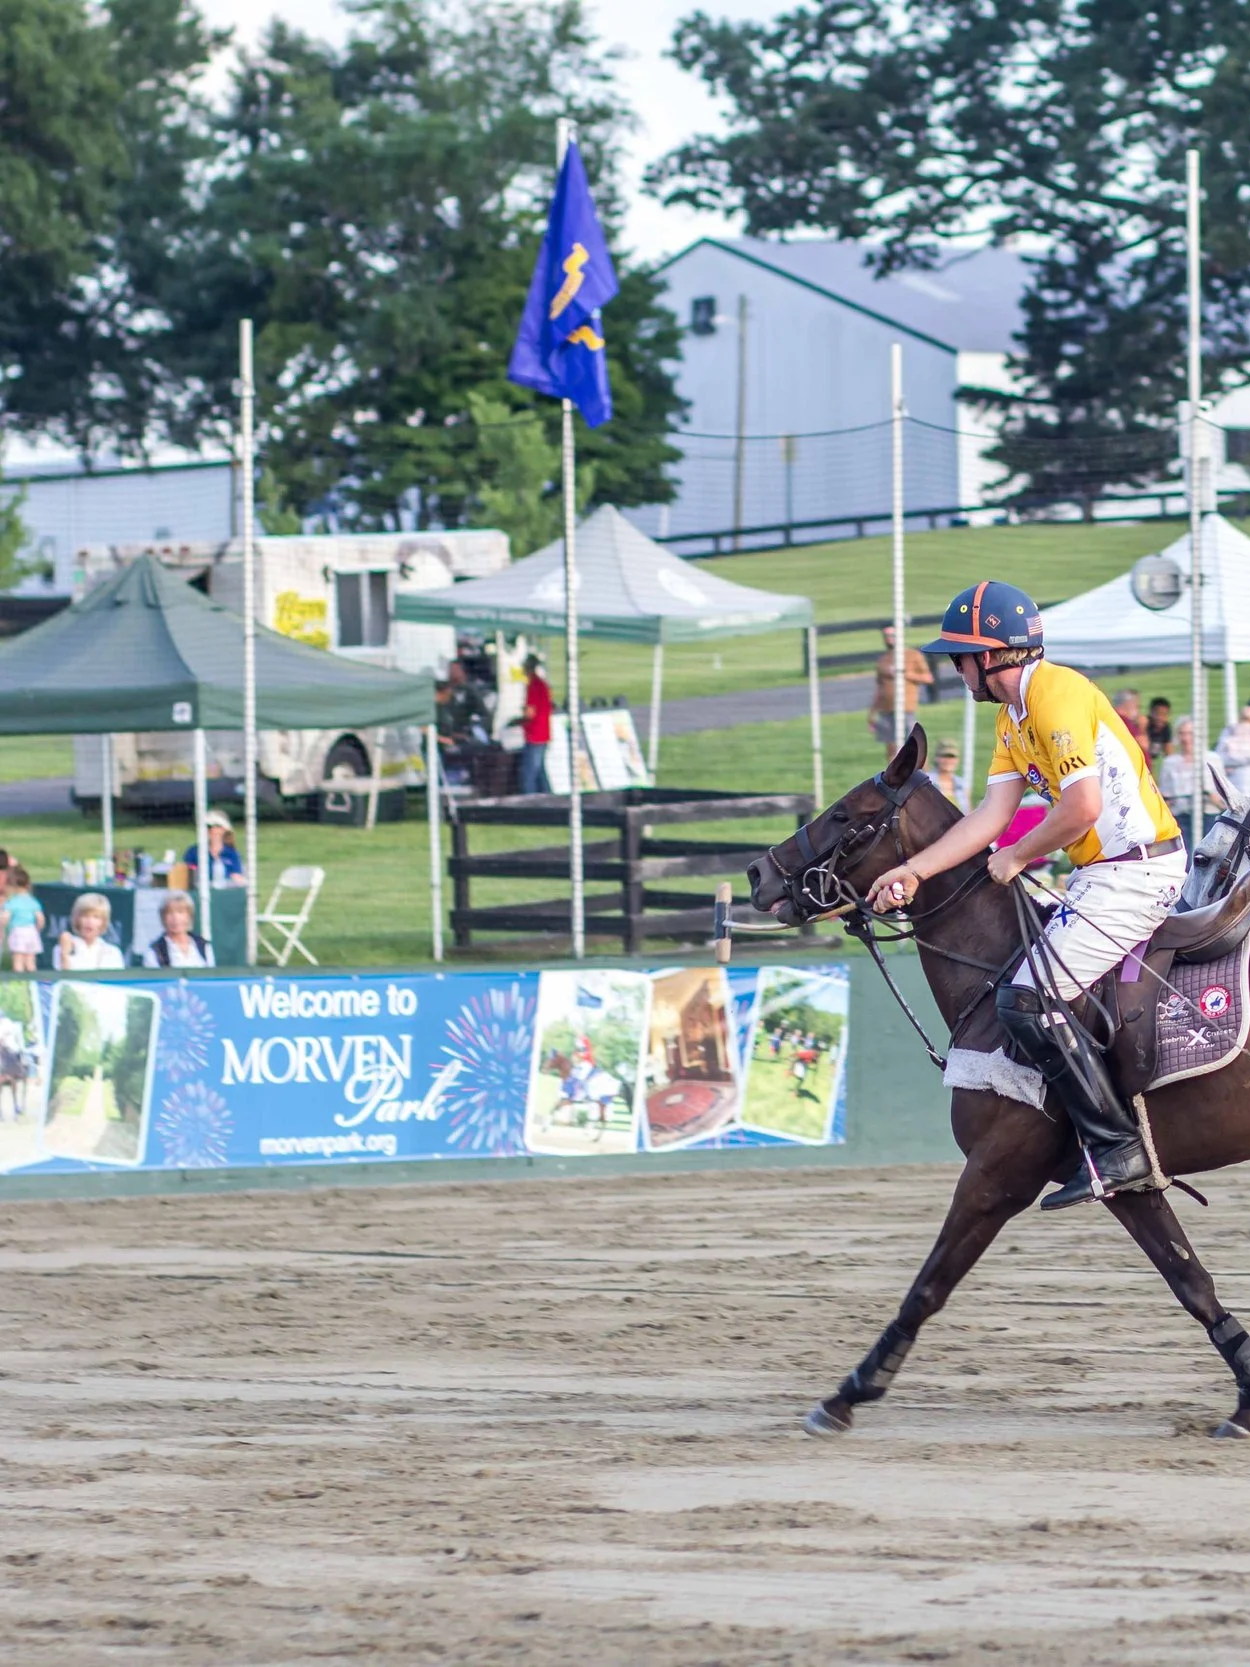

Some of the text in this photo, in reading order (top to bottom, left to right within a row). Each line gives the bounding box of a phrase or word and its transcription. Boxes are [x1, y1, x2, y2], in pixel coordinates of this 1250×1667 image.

[239, 984, 418, 1019] Welcome to
[221, 1034, 413, 1085] MORVEN
[334, 1059, 464, 1128] Park
[259, 1132, 397, 1156] morvenpark.org
